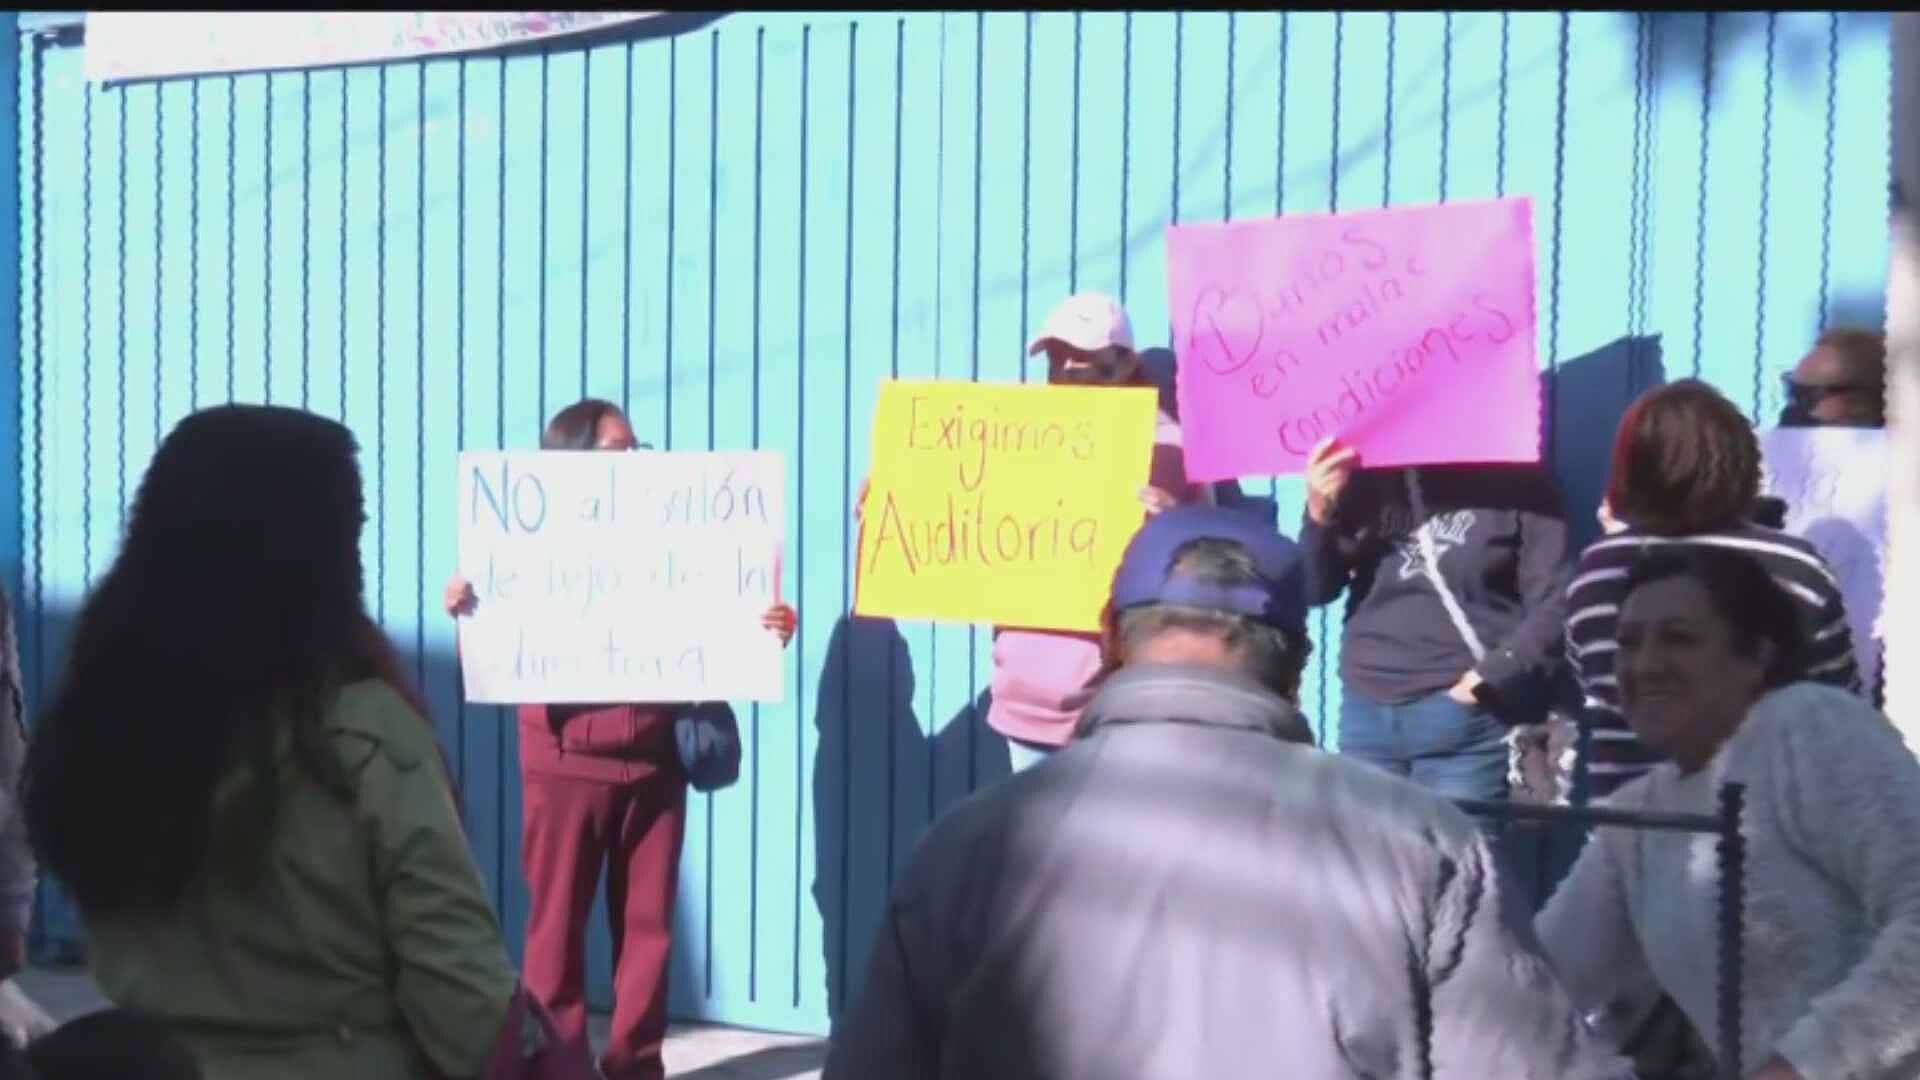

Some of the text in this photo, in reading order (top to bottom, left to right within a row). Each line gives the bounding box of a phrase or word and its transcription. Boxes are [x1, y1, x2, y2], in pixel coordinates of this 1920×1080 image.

[1251, 350, 1299, 398] en
[908, 396, 1095, 491] Exigimos
[472, 459, 768, 535] NO al alón
[489, 624, 705, 685] dirtora
